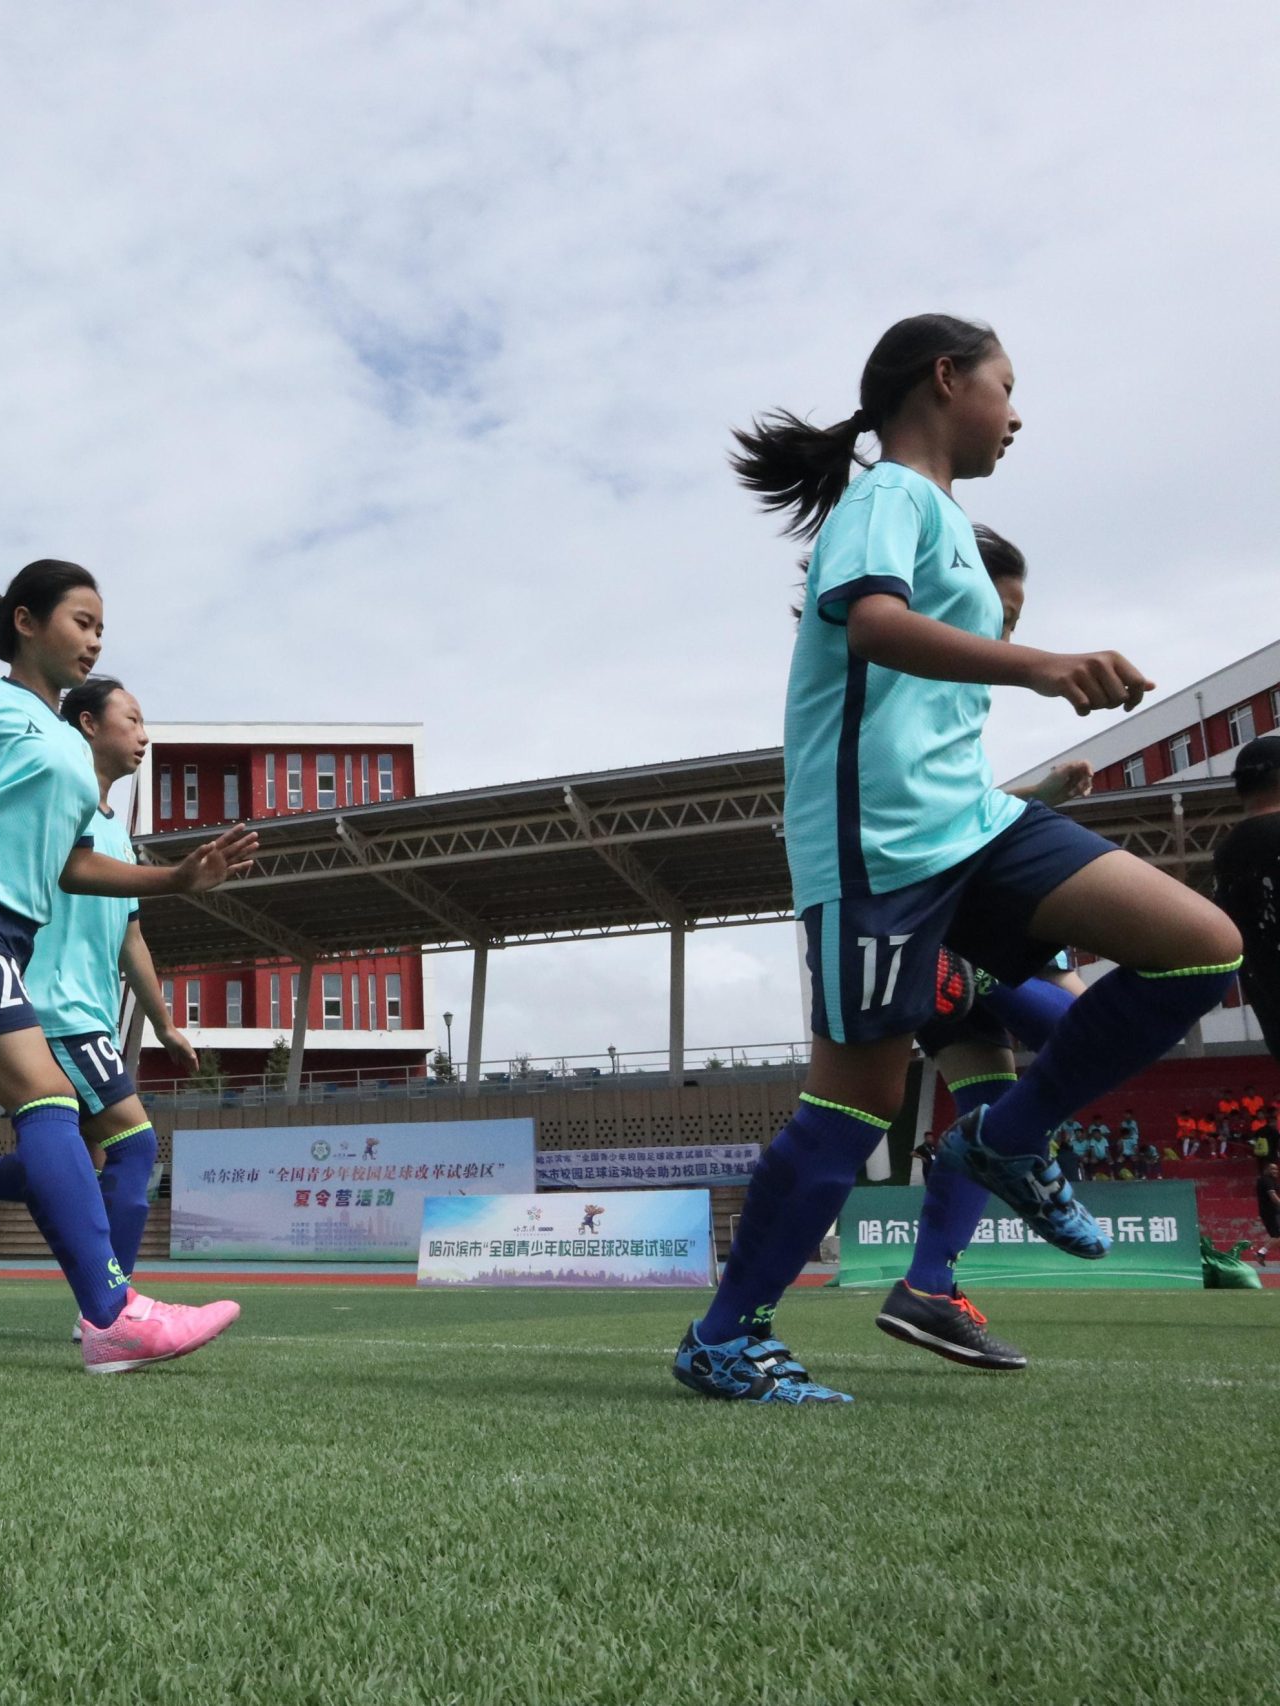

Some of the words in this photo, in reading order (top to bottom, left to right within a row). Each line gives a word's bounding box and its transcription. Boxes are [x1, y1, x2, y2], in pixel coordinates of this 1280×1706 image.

[857, 932, 914, 1011] 17
[80, 1036, 124, 1083] 19
[293, 1188, 395, 1208] 夏令营活动
